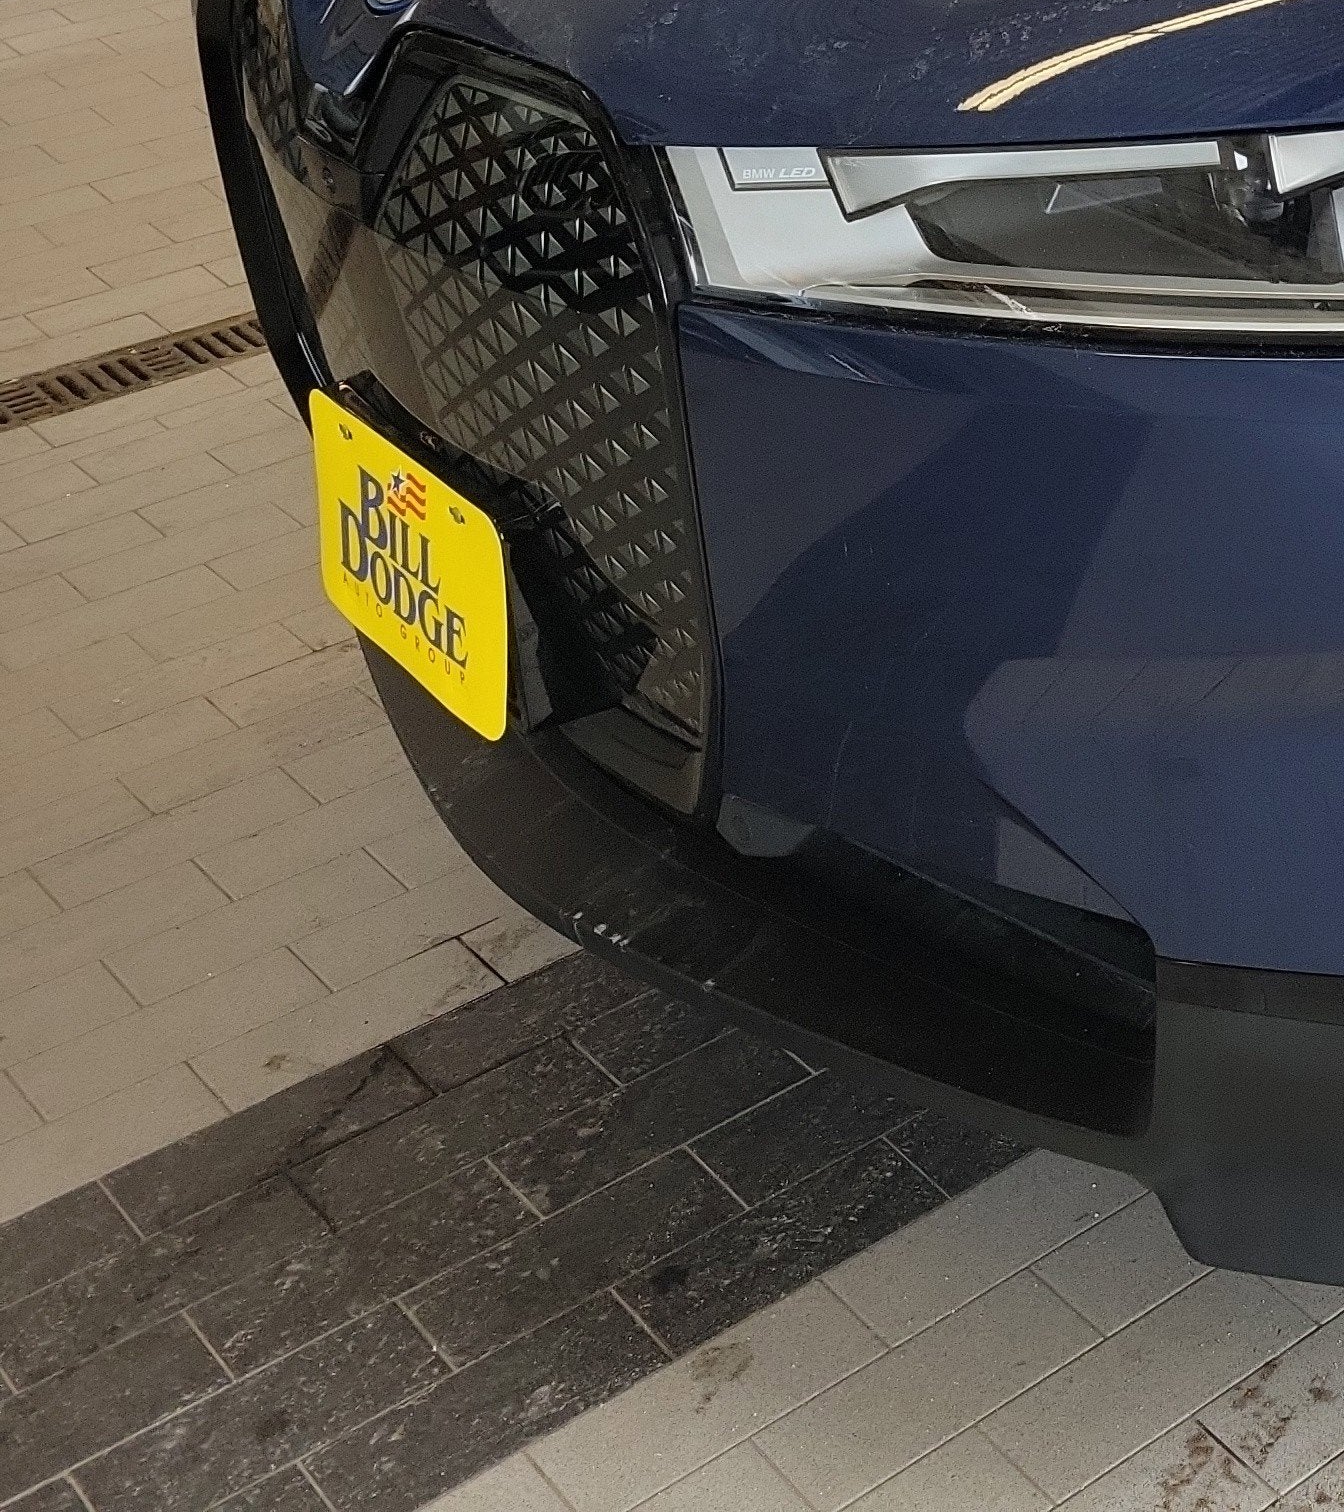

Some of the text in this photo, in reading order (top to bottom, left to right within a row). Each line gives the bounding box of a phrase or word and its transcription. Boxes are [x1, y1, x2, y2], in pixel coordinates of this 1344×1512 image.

[742, 167, 816, 179] BMW LED
[339, 499, 469, 670] DODGE
[357, 465, 442, 594] BILL
[342, 572, 466, 684] AUTO GROUP
